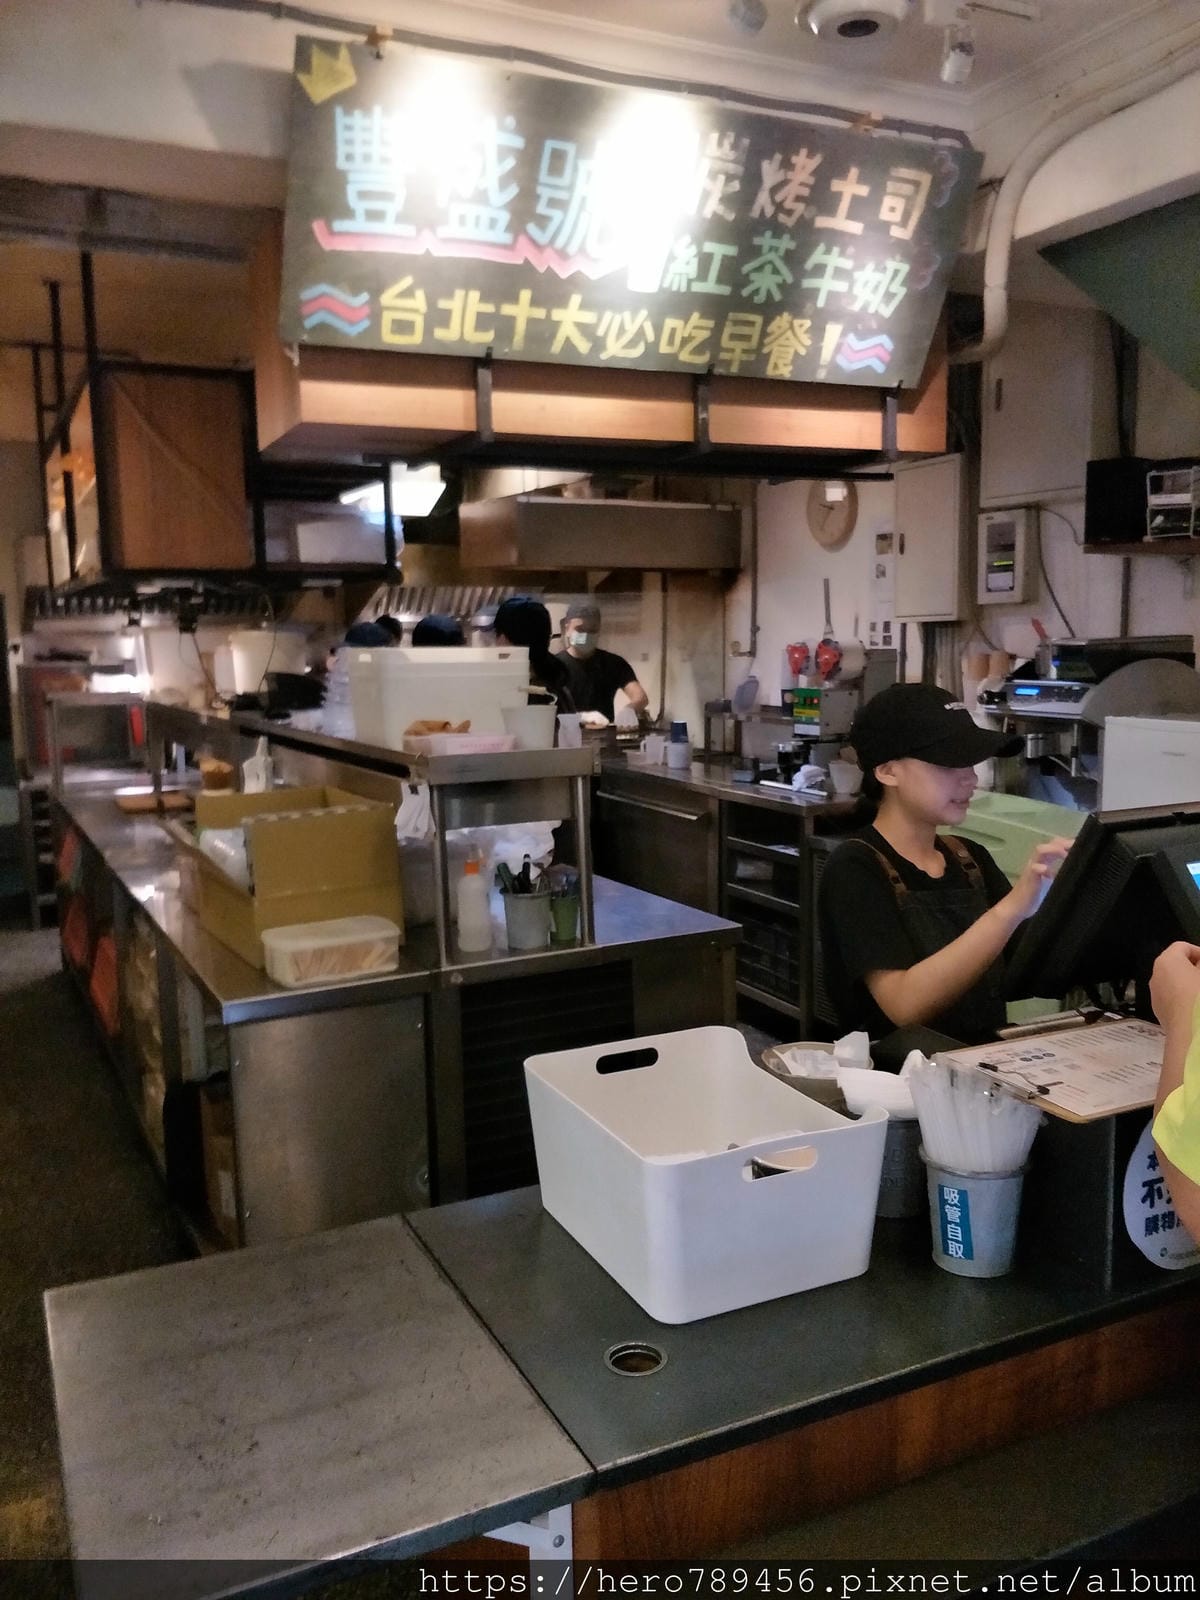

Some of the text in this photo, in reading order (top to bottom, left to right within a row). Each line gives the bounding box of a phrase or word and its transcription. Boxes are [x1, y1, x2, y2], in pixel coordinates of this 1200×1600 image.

[701, 131, 932, 240] 炭烤土司
[662, 230, 911, 318] 紅茶牛奶
[380, 275, 844, 379] 台北十大必吃早餐!
[943, 1186, 965, 1259] 吸管自取
